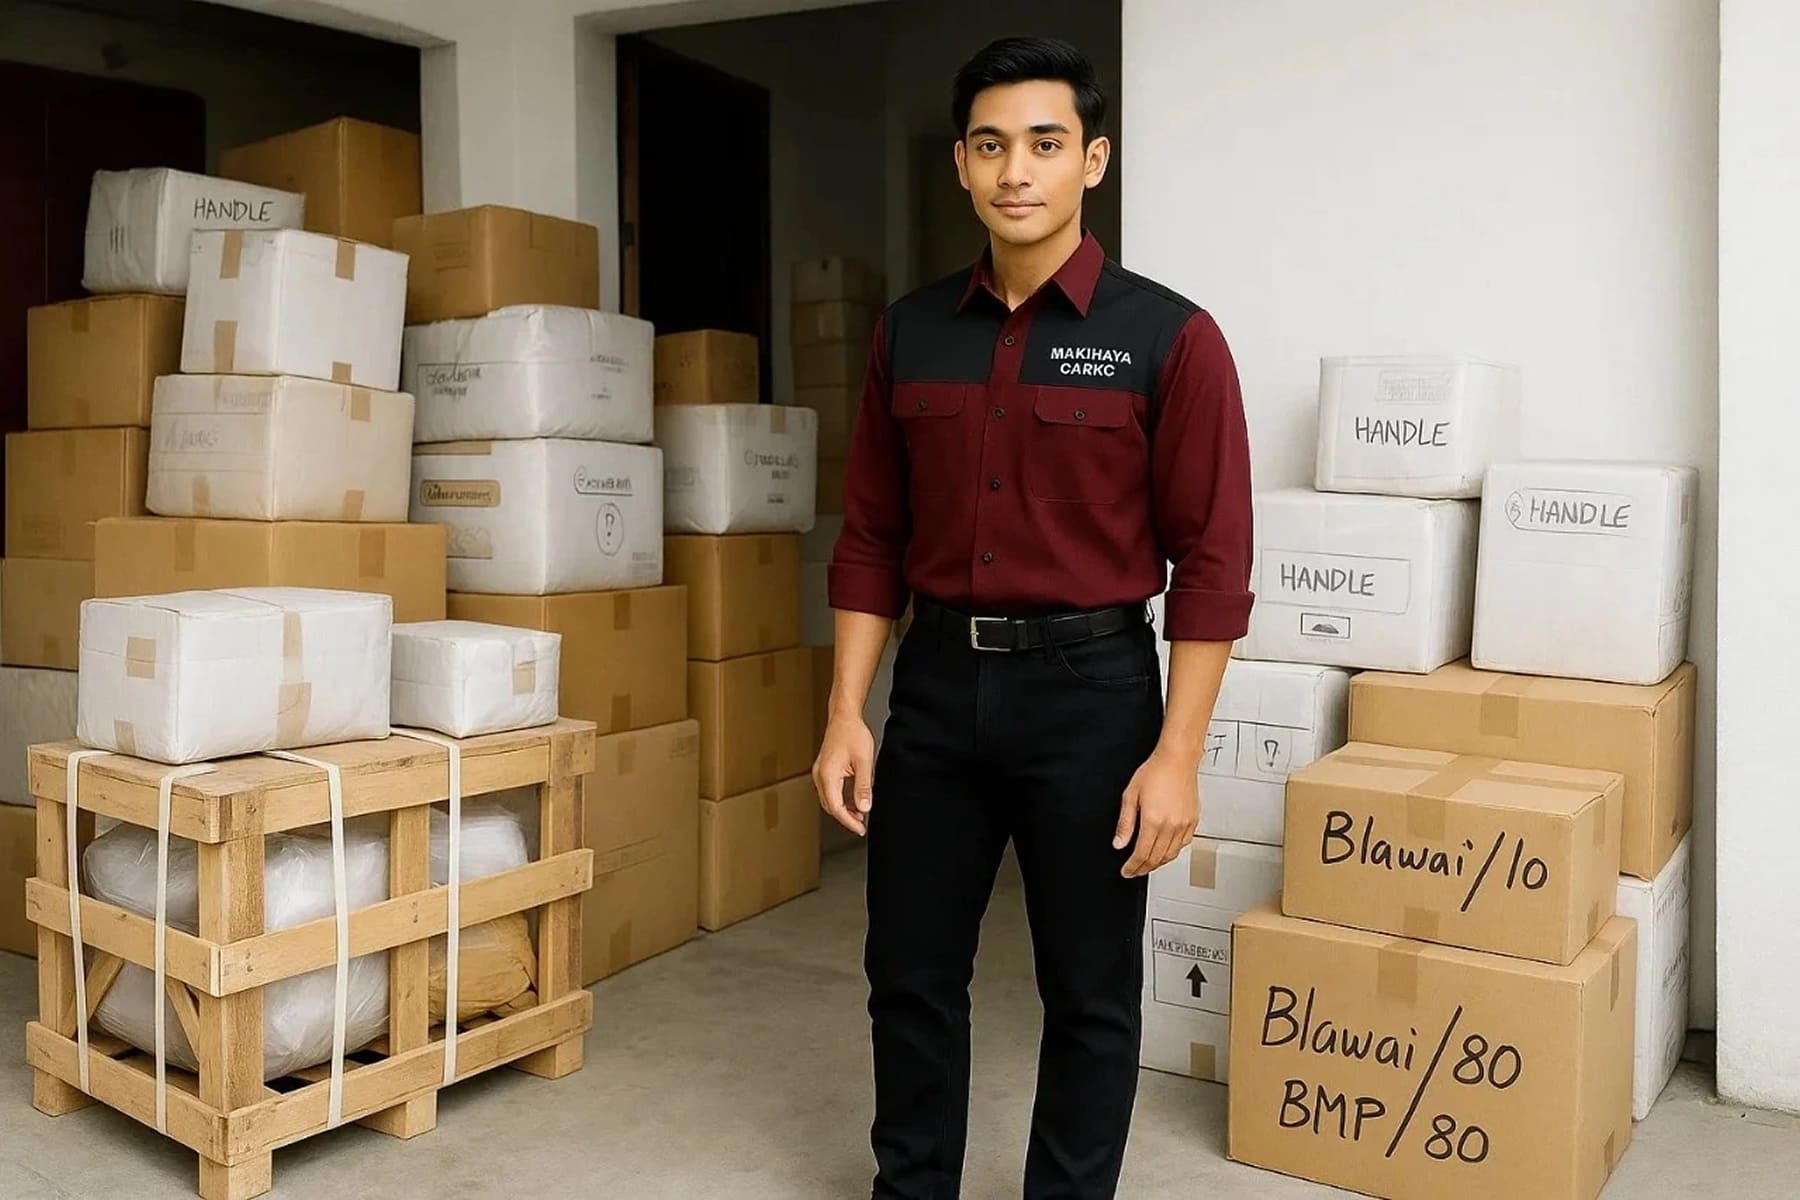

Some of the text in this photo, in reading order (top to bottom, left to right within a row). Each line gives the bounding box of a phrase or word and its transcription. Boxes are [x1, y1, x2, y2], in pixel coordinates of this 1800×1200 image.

[193, 197, 274, 222] HANDLE
[1050, 347, 1132, 365] MAKIHAYA
[1060, 362, 1116, 377] CARKC
[1354, 415, 1451, 447] HANDLE
[1528, 495, 1632, 529] HANDLE
[1279, 562, 1376, 597] HANDLE
